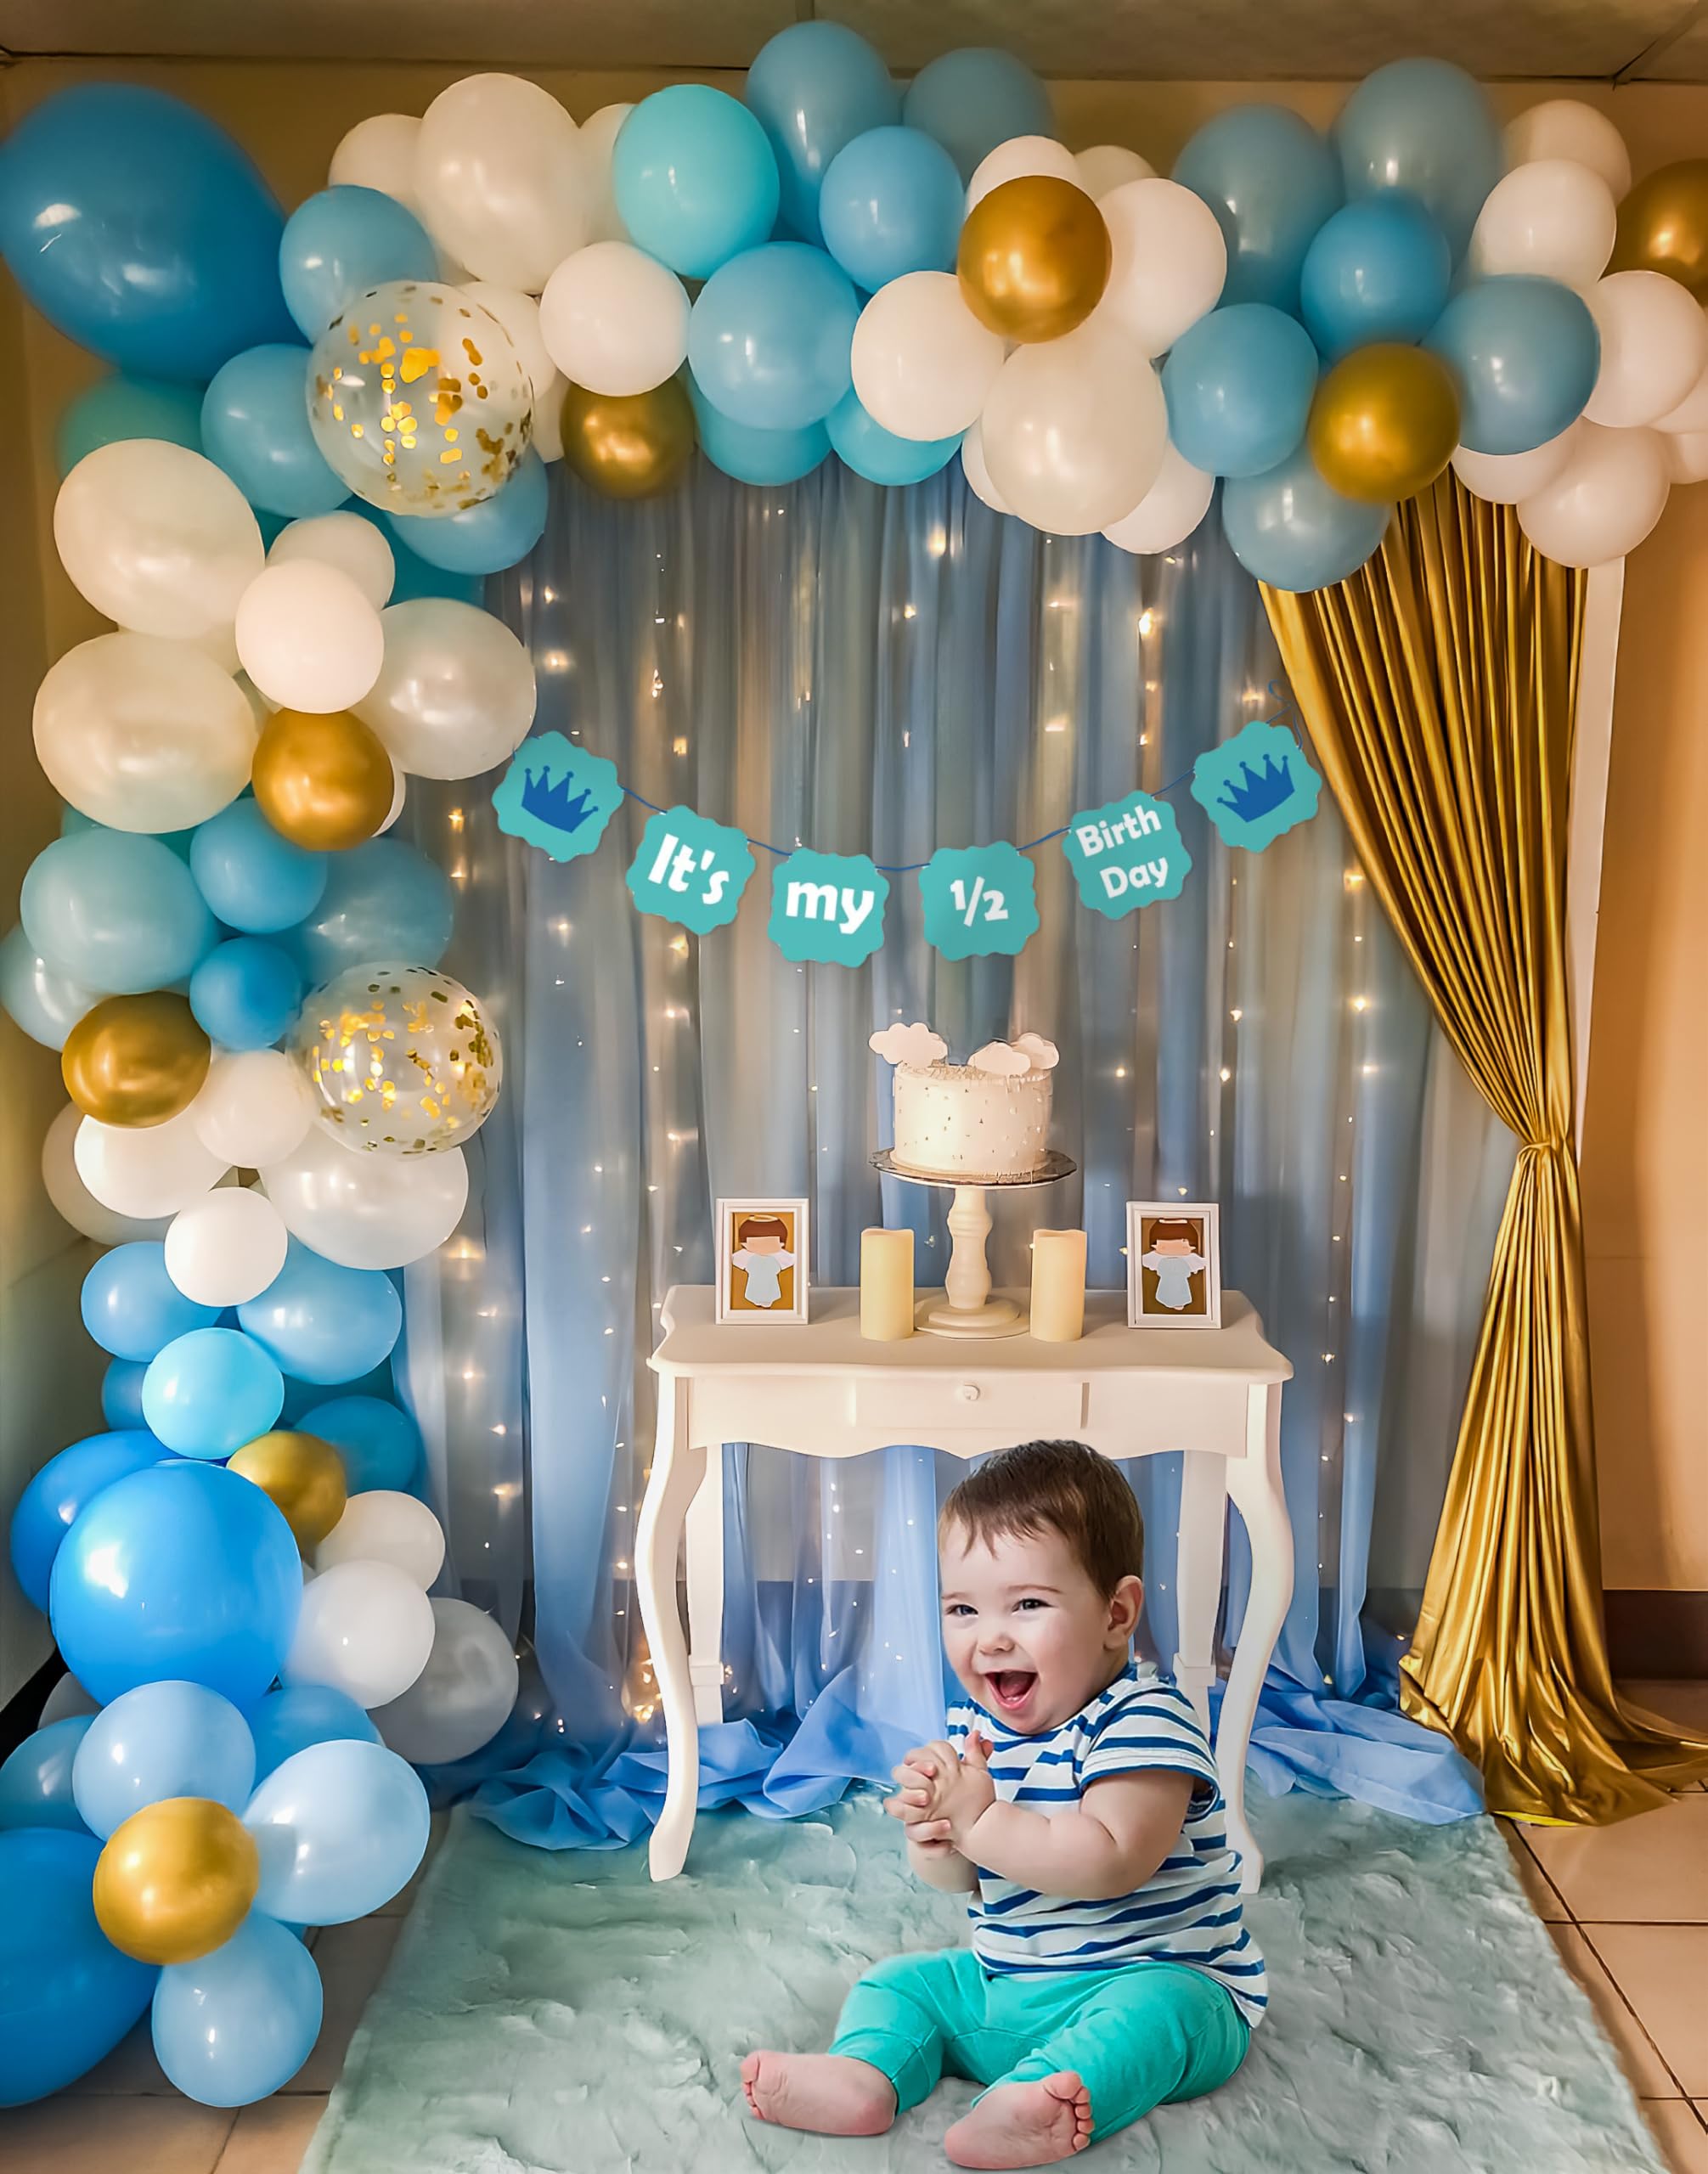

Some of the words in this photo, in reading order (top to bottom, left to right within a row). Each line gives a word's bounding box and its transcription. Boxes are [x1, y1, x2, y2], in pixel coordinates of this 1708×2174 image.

[648, 834, 730, 905] It's
[786, 881, 876, 934] my
[1076, 806, 1161, 857] Birth
[1100, 858, 1168, 898] Day
